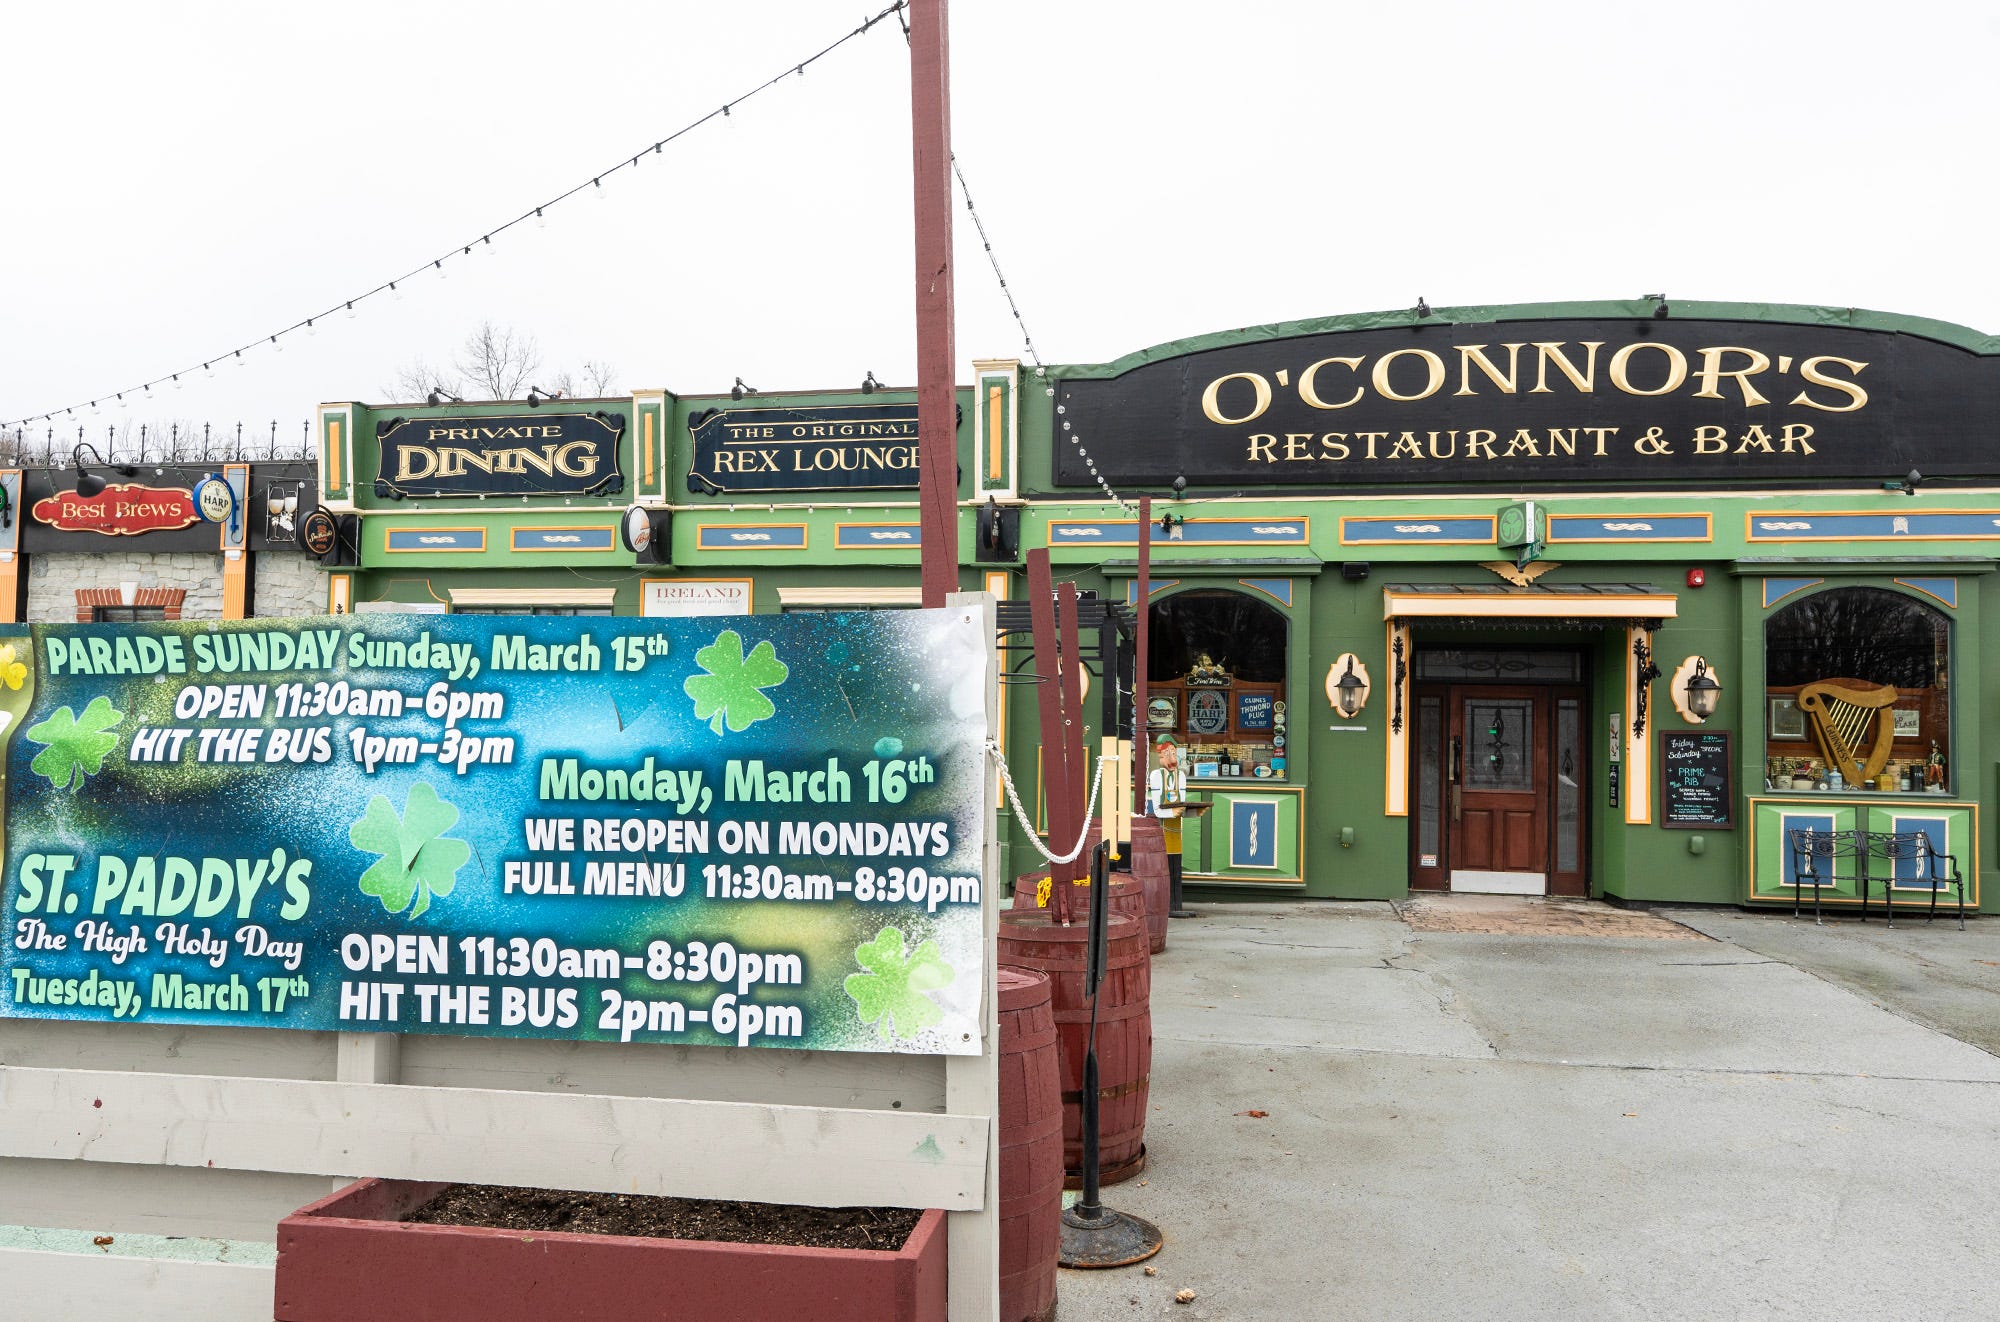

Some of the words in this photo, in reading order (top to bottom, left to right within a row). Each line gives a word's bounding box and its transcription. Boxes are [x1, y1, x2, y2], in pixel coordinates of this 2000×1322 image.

[1201, 341, 1869, 425] O'CONNOR'S
[428, 425, 562, 441] PRIVATE
[730, 427, 775, 438] THE
[792, 424, 915, 437] ORIGINAL
[1247, 427, 1620, 464] RESTAURANT
[1633, 426, 1674, 455] &
[1693, 423, 1817, 456] BAR
[395, 440, 599, 482] DINING
[713, 449, 781, 473] REX
[62, 501, 106, 518] Best
[115, 501, 182, 517] Brews
[204, 494, 229, 509] HARP
[657, 588, 742, 598] IRELAND
[46, 635, 187, 675] PARADE
[193, 630, 341, 673] SUNDAY
[348, 632, 481, 680] Sunday,
[490, 633, 600, 671] March
[610, 633, 669, 672] 15th
[175, 684, 267, 719] OPEN
[1192, 709, 1224, 718] HARP
[1240, 702, 1271, 714] THOMOND
[1248, 711, 1265, 719] PLUG
[130, 728, 194, 762] HIT
[199, 728, 260, 763] THE
[265, 727, 332, 763] BUS
[349, 727, 515, 775] 1pm-3pm
[1668, 750, 1701, 759] Saturday
[1670, 738, 1695, 748] Friday
[1825, 725, 1850, 763] GUINNESS
[539, 756, 713, 815] Monday,
[724, 757, 851, 804] March
[861, 756, 934, 804] 16th
[1678, 767, 1705, 777] PRIME
[1684, 777, 1699, 786] RIB
[525, 819, 578, 852] WE
[584, 818, 709, 854] REOPEN
[717, 821, 770, 855] ON
[779, 821, 949, 857] MONDAYS
[15, 853, 79, 914] ST.
[92, 847, 313, 921] PADDY'S
[503, 862, 575, 895] FULL
[582, 862, 685, 898] MENU
[15, 918, 67, 951] The
[75, 920, 147, 965] High
[155, 922, 228, 968] Holy
[235, 925, 304, 970] Day
[340, 933, 449, 975] OPEN
[11, 968, 142, 1018] Tuesday,
[151, 973, 249, 1012] March
[257, 974, 310, 1013] 17th
[339, 982, 404, 1022] HIT
[414, 983, 491, 1025] THE
[501, 986, 579, 1028] BUS
[598, 989, 803, 1047] 2pm-6pm
